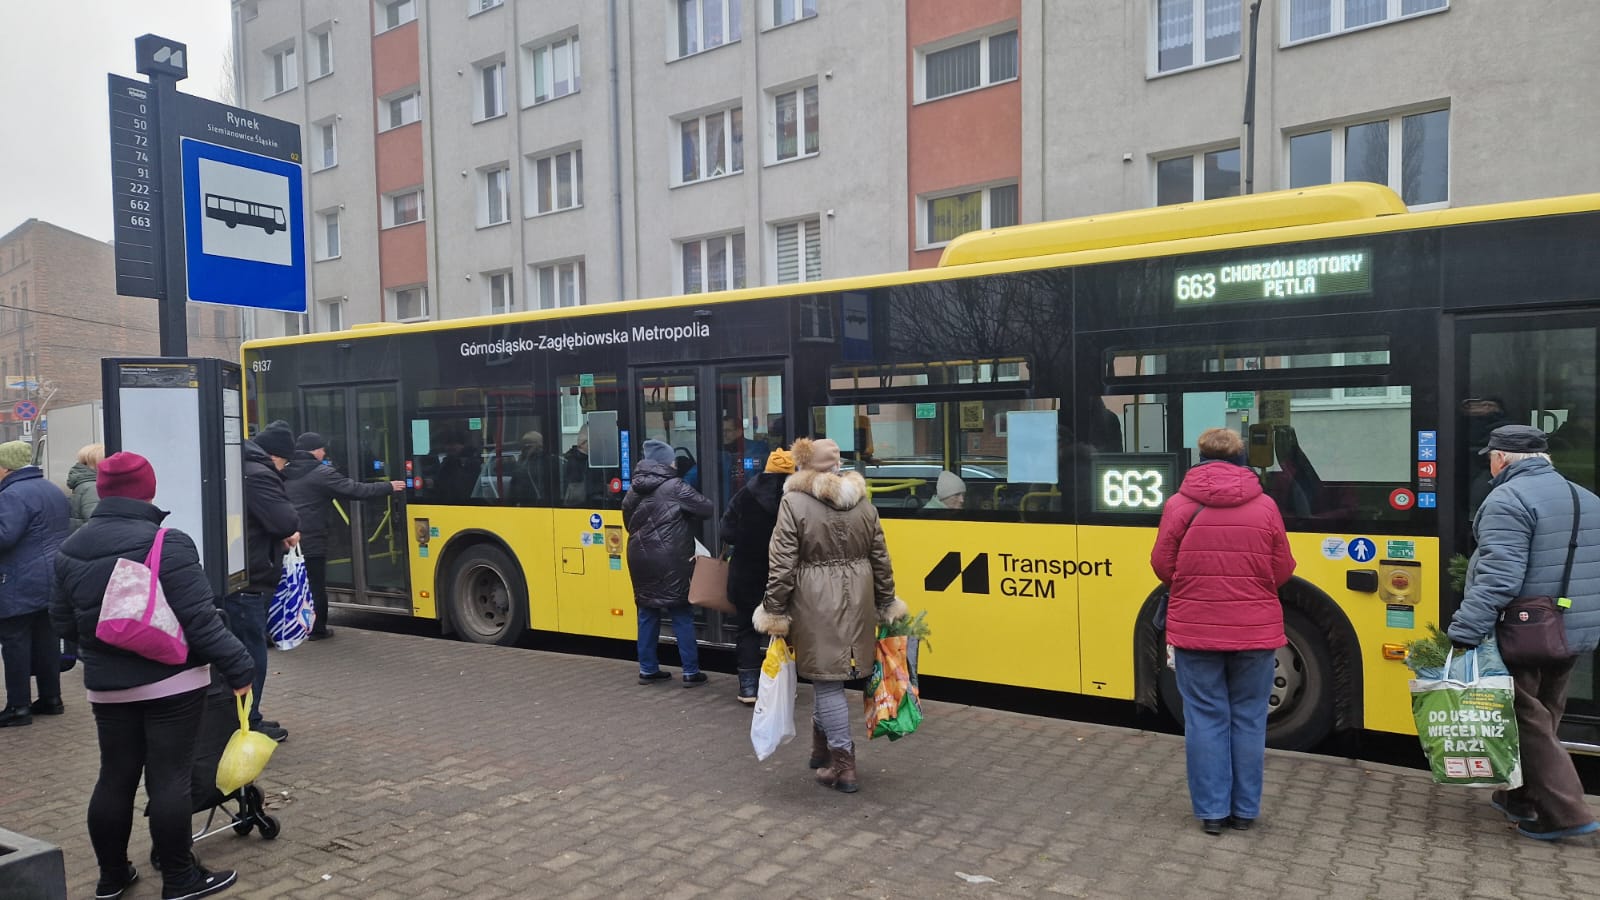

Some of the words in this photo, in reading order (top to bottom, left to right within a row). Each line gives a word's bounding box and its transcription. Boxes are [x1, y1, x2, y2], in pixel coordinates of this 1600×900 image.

[139, 104, 147, 114] 0
[133, 119, 147, 130] 50
[226, 111, 260, 131] Rynek
[207, 124, 254, 142] Siemianowice
[135, 135, 148, 146] 72
[135, 151, 148, 162] 74
[137, 168, 149, 178] 91
[130, 183, 150, 195] 222
[130, 200, 150, 211] 662
[130, 216, 151, 228] 663
[1220, 259, 1294, 283] CHORZÓW
[1295, 253, 1363, 276] BATORY
[1176, 272, 1216, 300] 663
[459, 329, 629, 357] Górnośląsko-Zagłębiowska
[631, 321, 710, 343] Metropolia
[252, 359, 272, 372] 6137
[1102, 469, 1164, 508] 663
[998, 552, 1113, 580] Transport
[999, 577, 1056, 599] GZM
[1428, 710, 1447, 723] DO
[1428, 725, 1477, 740] WIĘCEJ
[1481, 723, 1505, 738] NIŻ
